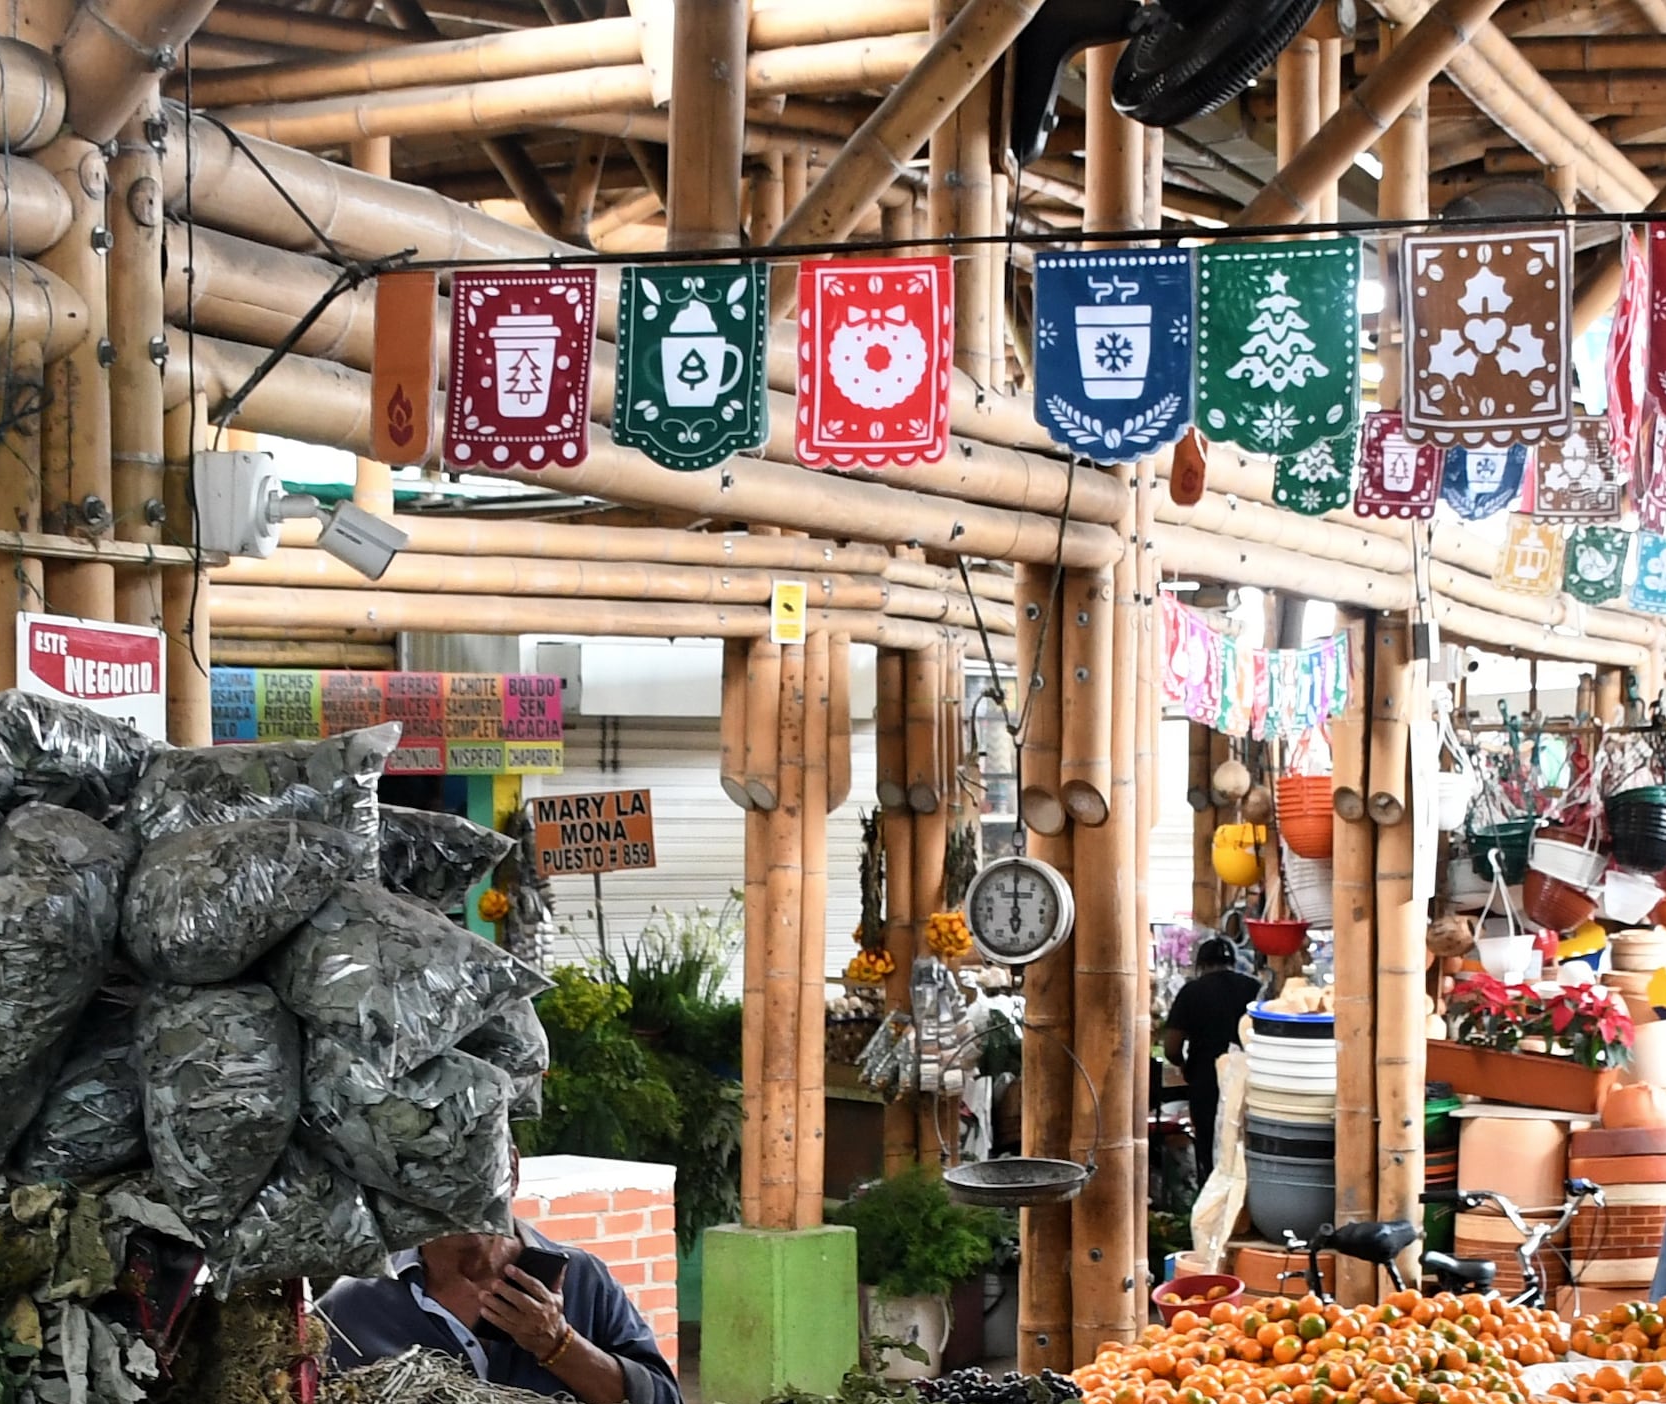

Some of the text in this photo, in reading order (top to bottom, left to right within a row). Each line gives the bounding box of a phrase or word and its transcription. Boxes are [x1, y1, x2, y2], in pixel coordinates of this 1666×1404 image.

[34, 630, 69, 656] ESTE
[64, 655, 154, 694] NEGOCIO
[262, 673, 314, 689] TACHES
[450, 677, 497, 696] ACHOTE
[508, 678, 555, 697] BOLDO
[264, 690, 312, 705] CACAO
[263, 706, 313, 721] RIEGOS
[519, 699, 546, 717] SEN
[506, 719, 560, 738] ACACIA
[449, 749, 502, 769] NISPERO
[538, 793, 646, 823] MARY LA
[560, 819, 627, 845] MONA
[542, 846, 604, 873] PUESTO
[623, 842, 650, 866] 859
